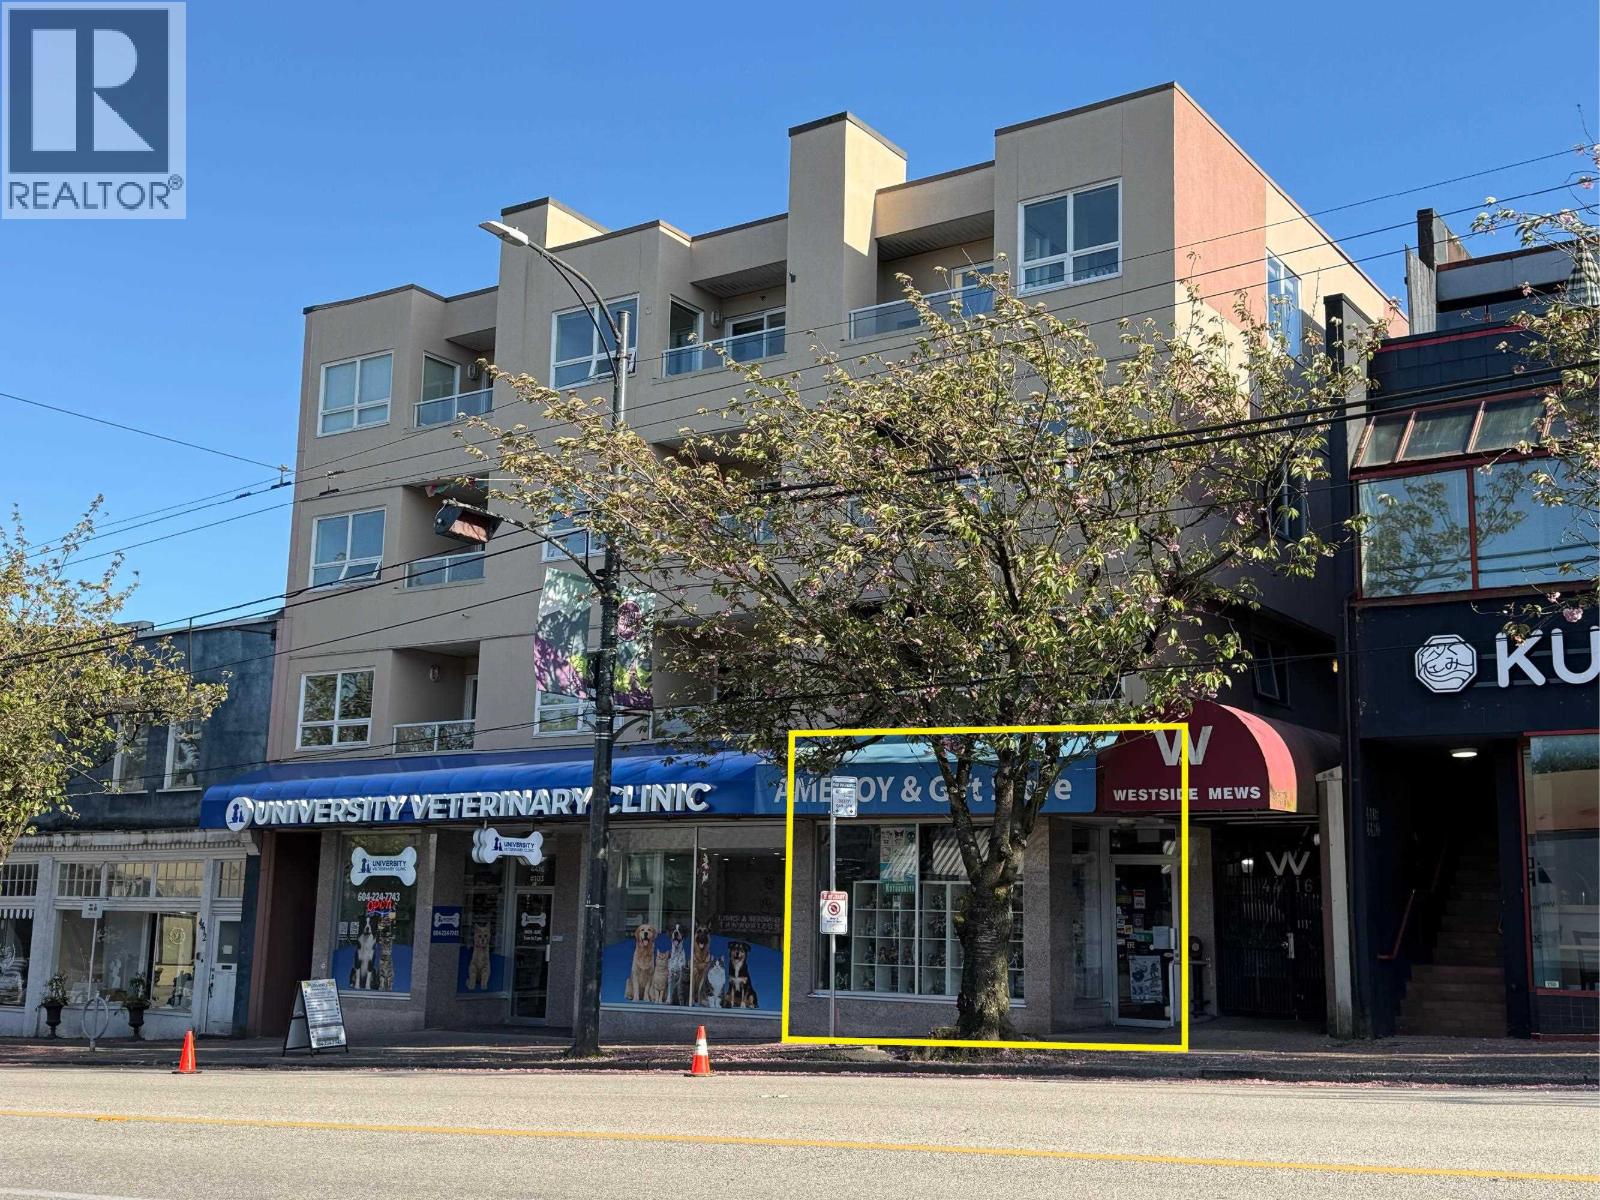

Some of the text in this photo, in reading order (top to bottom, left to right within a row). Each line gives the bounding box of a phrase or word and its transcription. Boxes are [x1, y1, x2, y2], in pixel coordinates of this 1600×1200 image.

[1154, 726, 1213, 766] W
[901, 776, 922, 802] &
[928, 775, 983, 802] Gt
[1208, 786, 1261, 800] MEWS
[253, 782, 712, 825] UNIVERSITY VETERINARY CLINIC
[503, 841, 535, 849] UNIVERSITY
[1265, 851, 1311, 876] W
[357, 891, 401, 902] 604-224-7743
